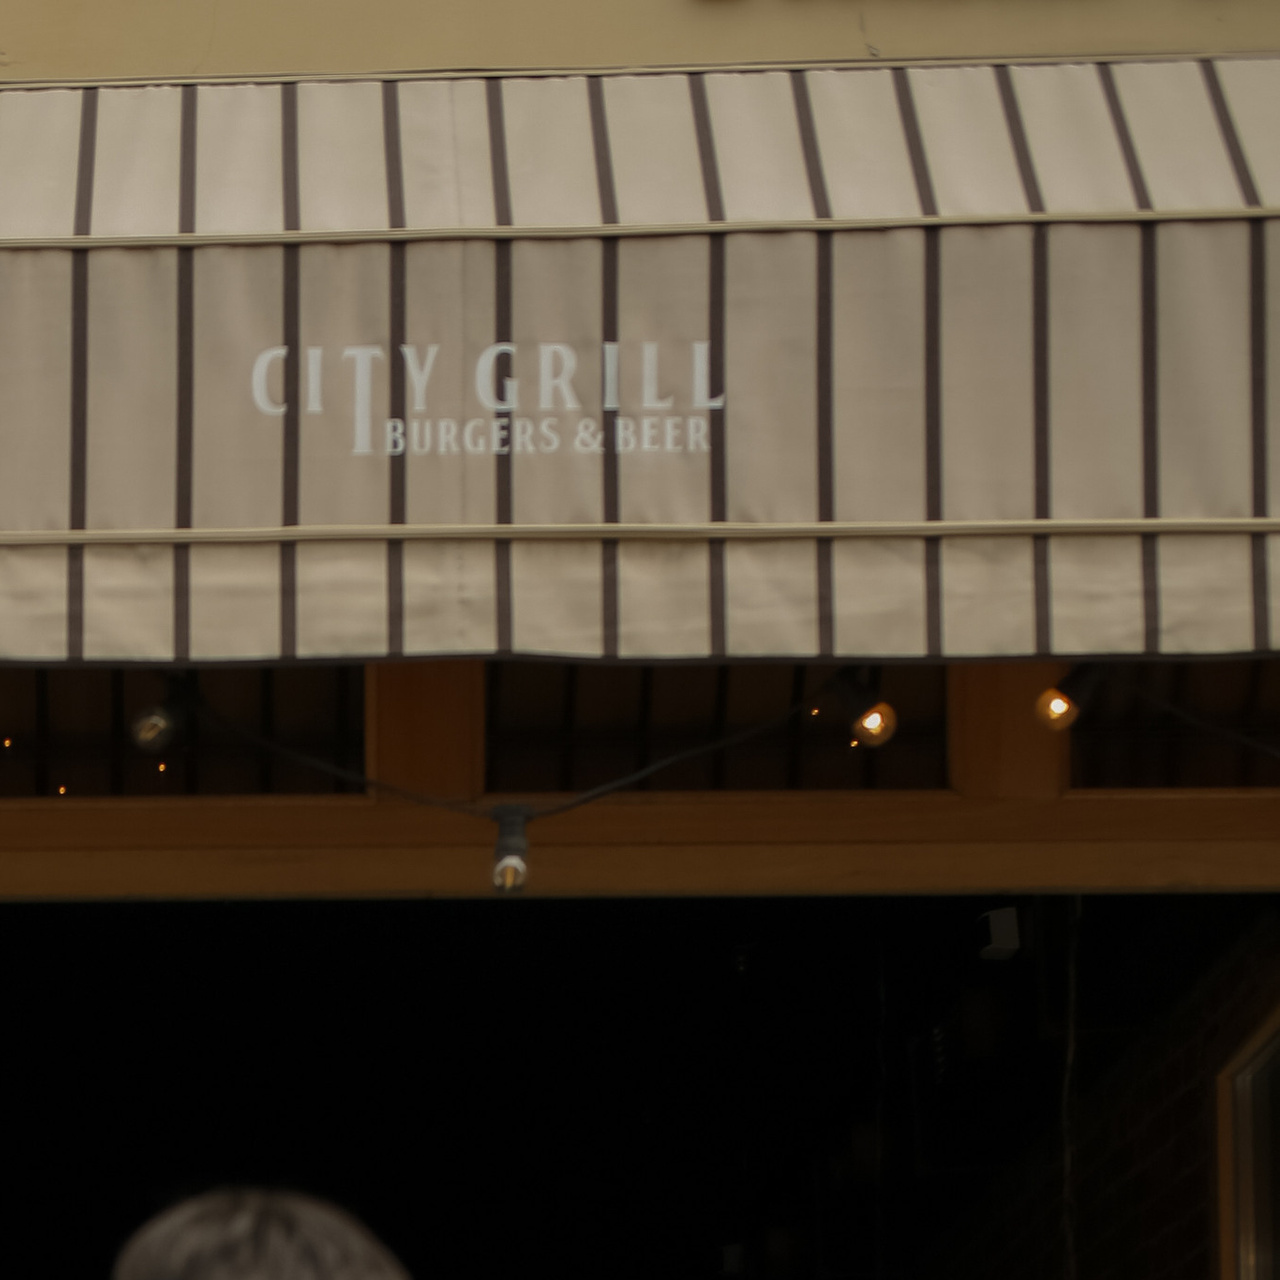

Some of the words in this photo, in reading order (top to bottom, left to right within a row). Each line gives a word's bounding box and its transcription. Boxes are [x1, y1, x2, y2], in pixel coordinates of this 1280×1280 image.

[252, 343, 441, 457] CITY
[474, 341, 726, 412] GRILL
[385, 415, 561, 456] BURGERS
[573, 417, 606, 453] &
[614, 414, 713, 453] BEER
